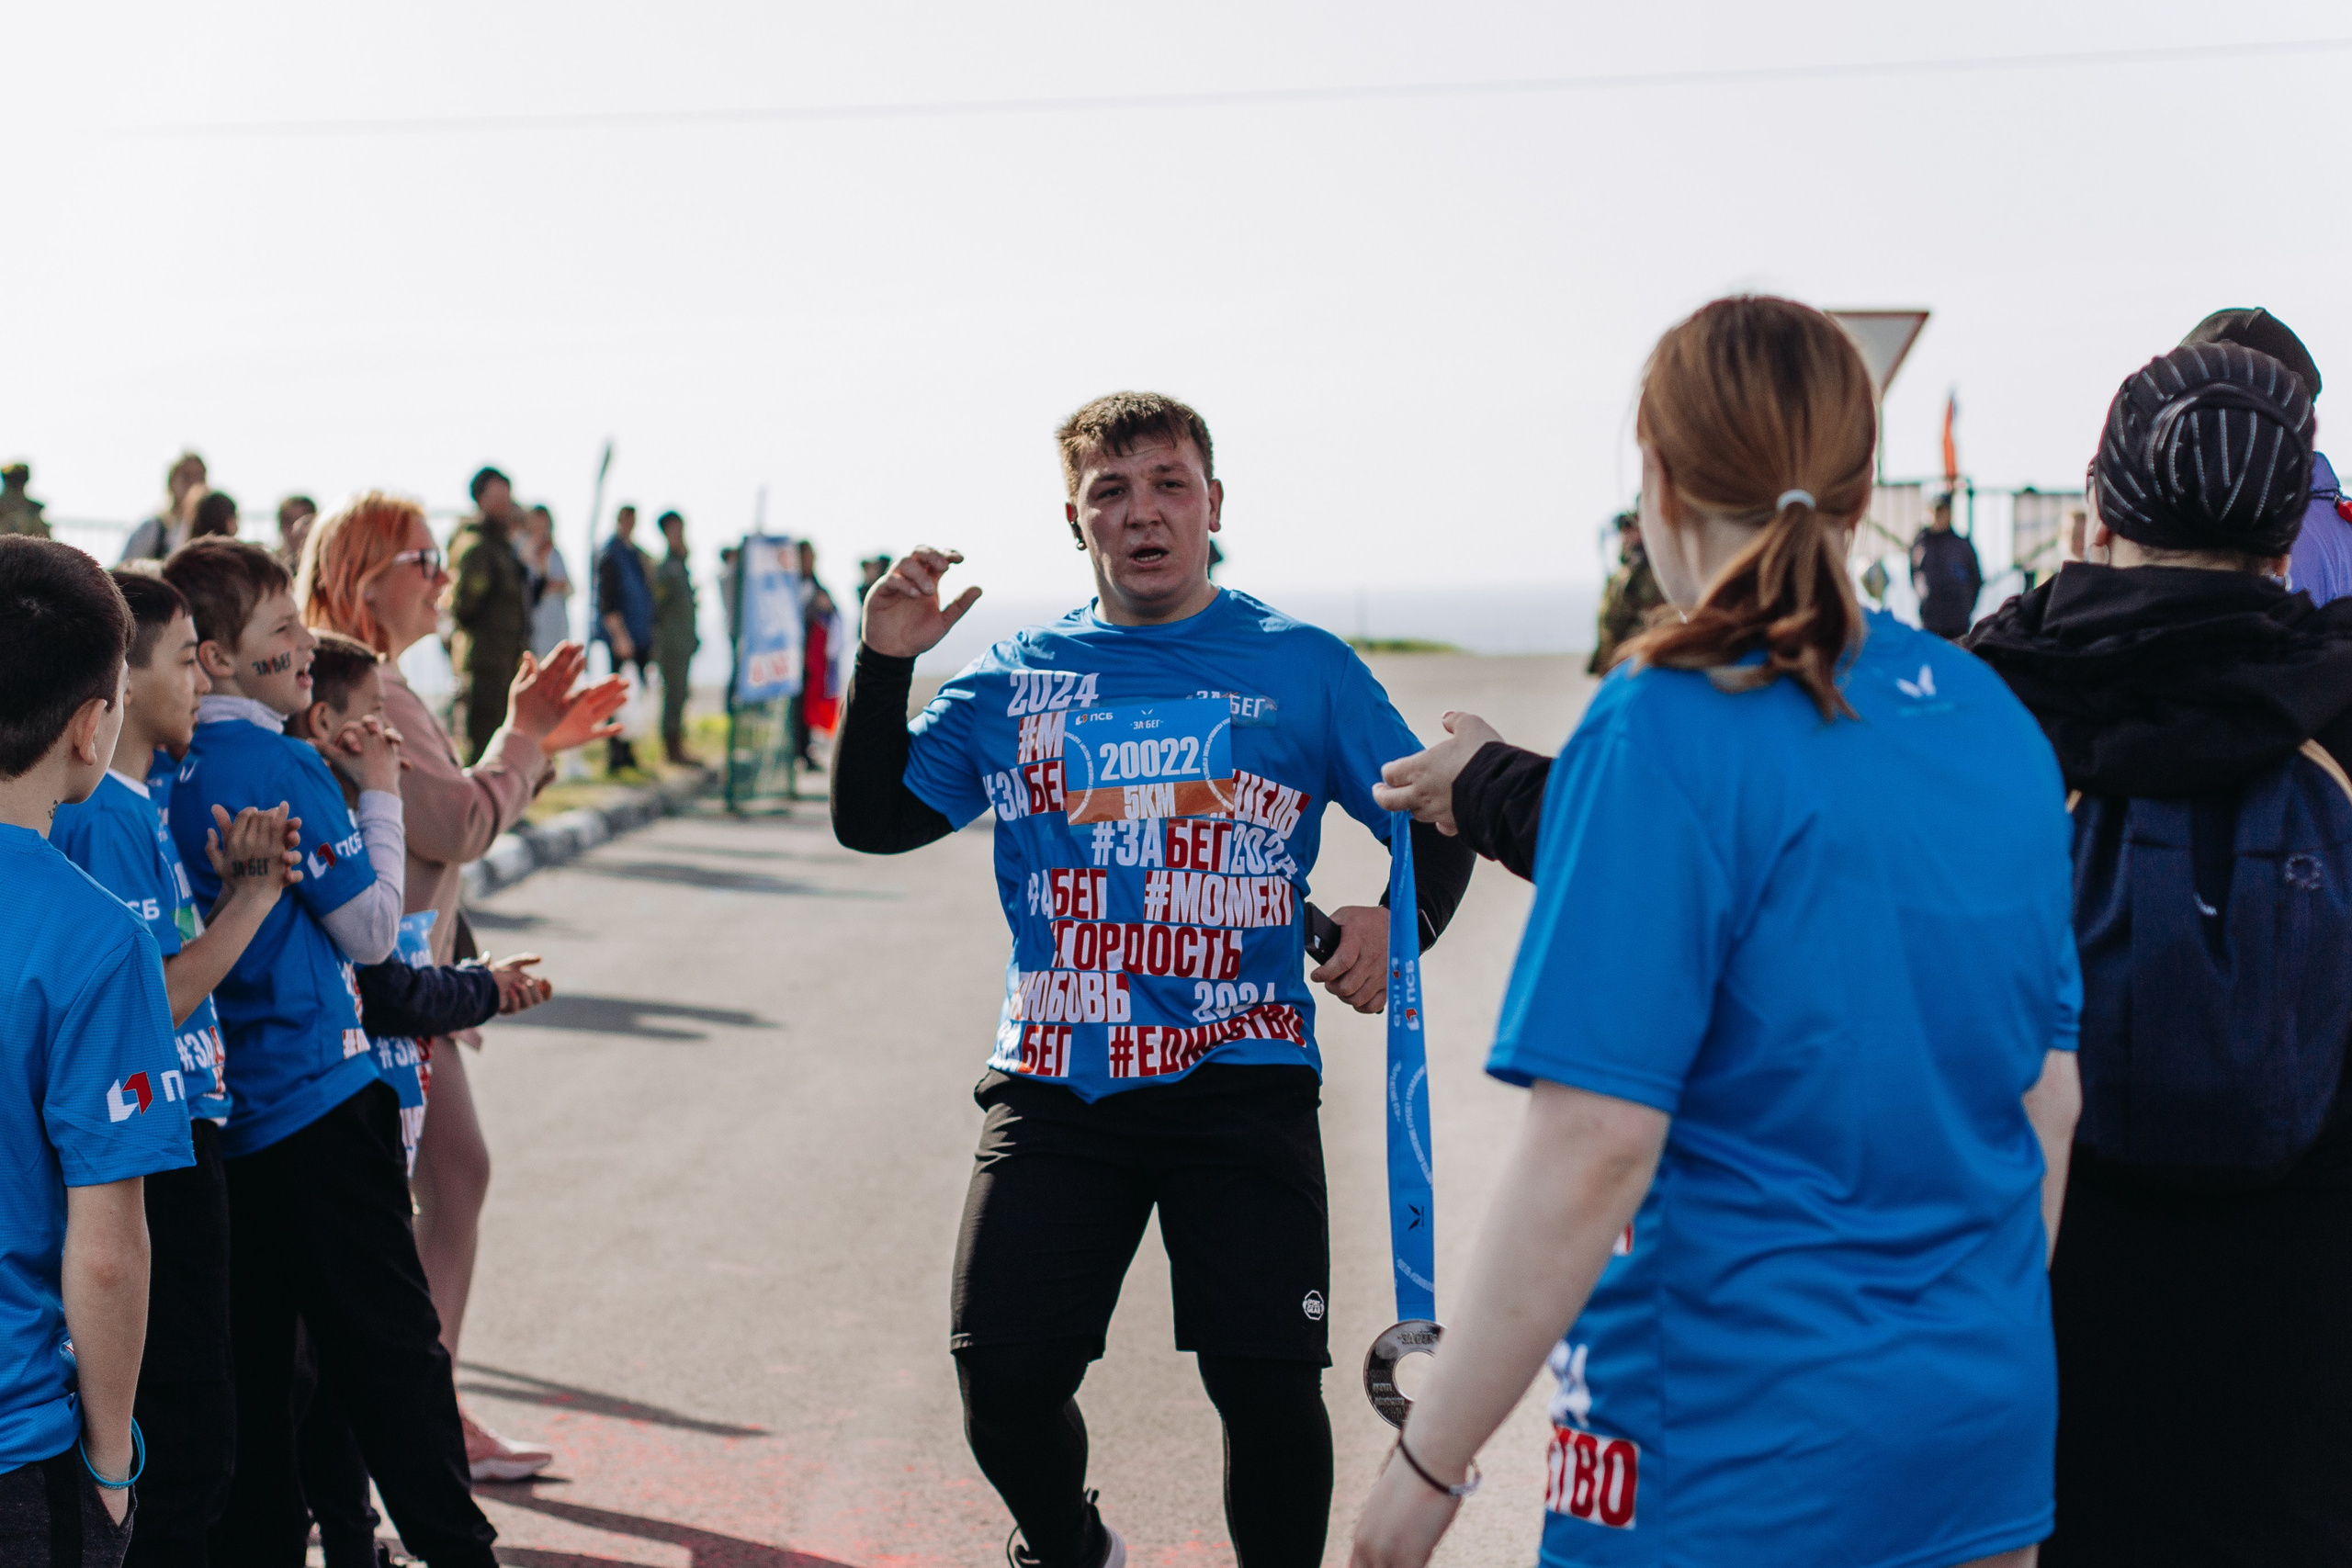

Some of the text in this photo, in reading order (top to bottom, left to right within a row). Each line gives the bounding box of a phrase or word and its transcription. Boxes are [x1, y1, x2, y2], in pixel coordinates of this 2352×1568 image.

[1007, 669, 1100, 716] 2024
[1090, 713, 1114, 721] ПСБ
[1100, 737, 1201, 781] 20022
